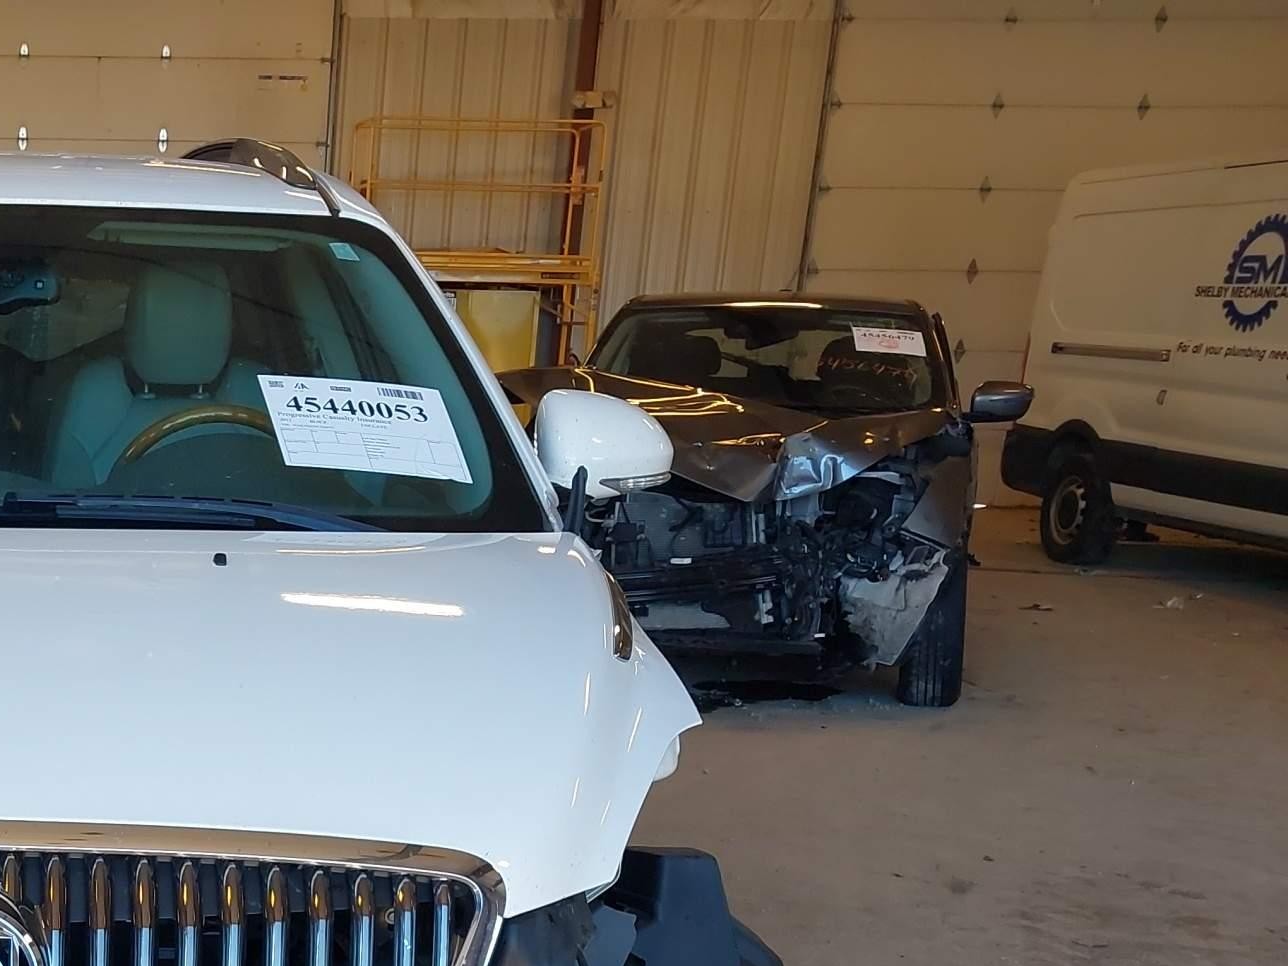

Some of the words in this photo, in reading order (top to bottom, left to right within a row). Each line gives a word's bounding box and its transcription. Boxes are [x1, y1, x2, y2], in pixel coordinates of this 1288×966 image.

[1195, 286, 1229, 298] SHELBY
[1231, 286, 1288, 298] MECHANICA
[1177, 341, 1191, 352] For
[1192, 343, 1204, 353] all
[1204, 346, 1224, 357] your
[1224, 345, 1267, 361] plumbing
[1268, 350, 1288, 360] nee
[286, 395, 429, 423] 45440053
[278, 411, 321, 419] Progressive
[323, 413, 354, 422] Casualty
[357, 417, 392, 425] Insurance
